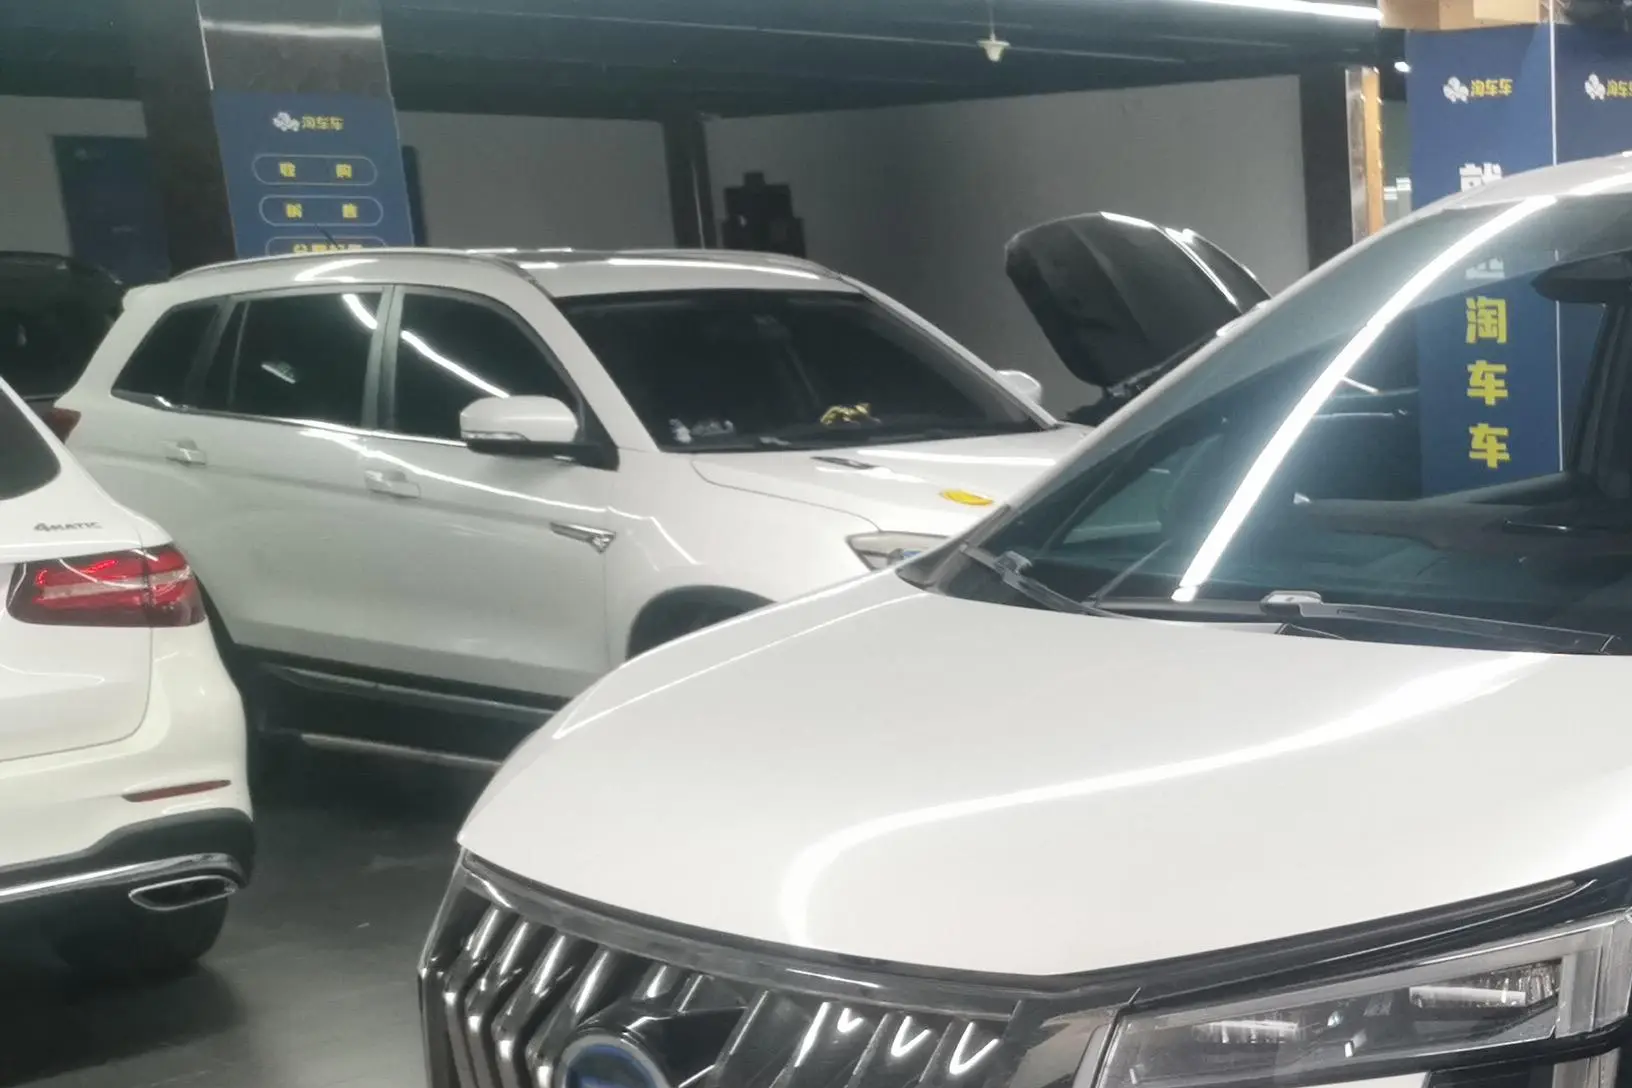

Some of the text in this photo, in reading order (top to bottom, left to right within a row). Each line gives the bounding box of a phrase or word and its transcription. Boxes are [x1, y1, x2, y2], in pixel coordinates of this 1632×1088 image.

[1471, 78, 1513, 97] 淘车车
[1465, 295, 1510, 468] 淘车车
